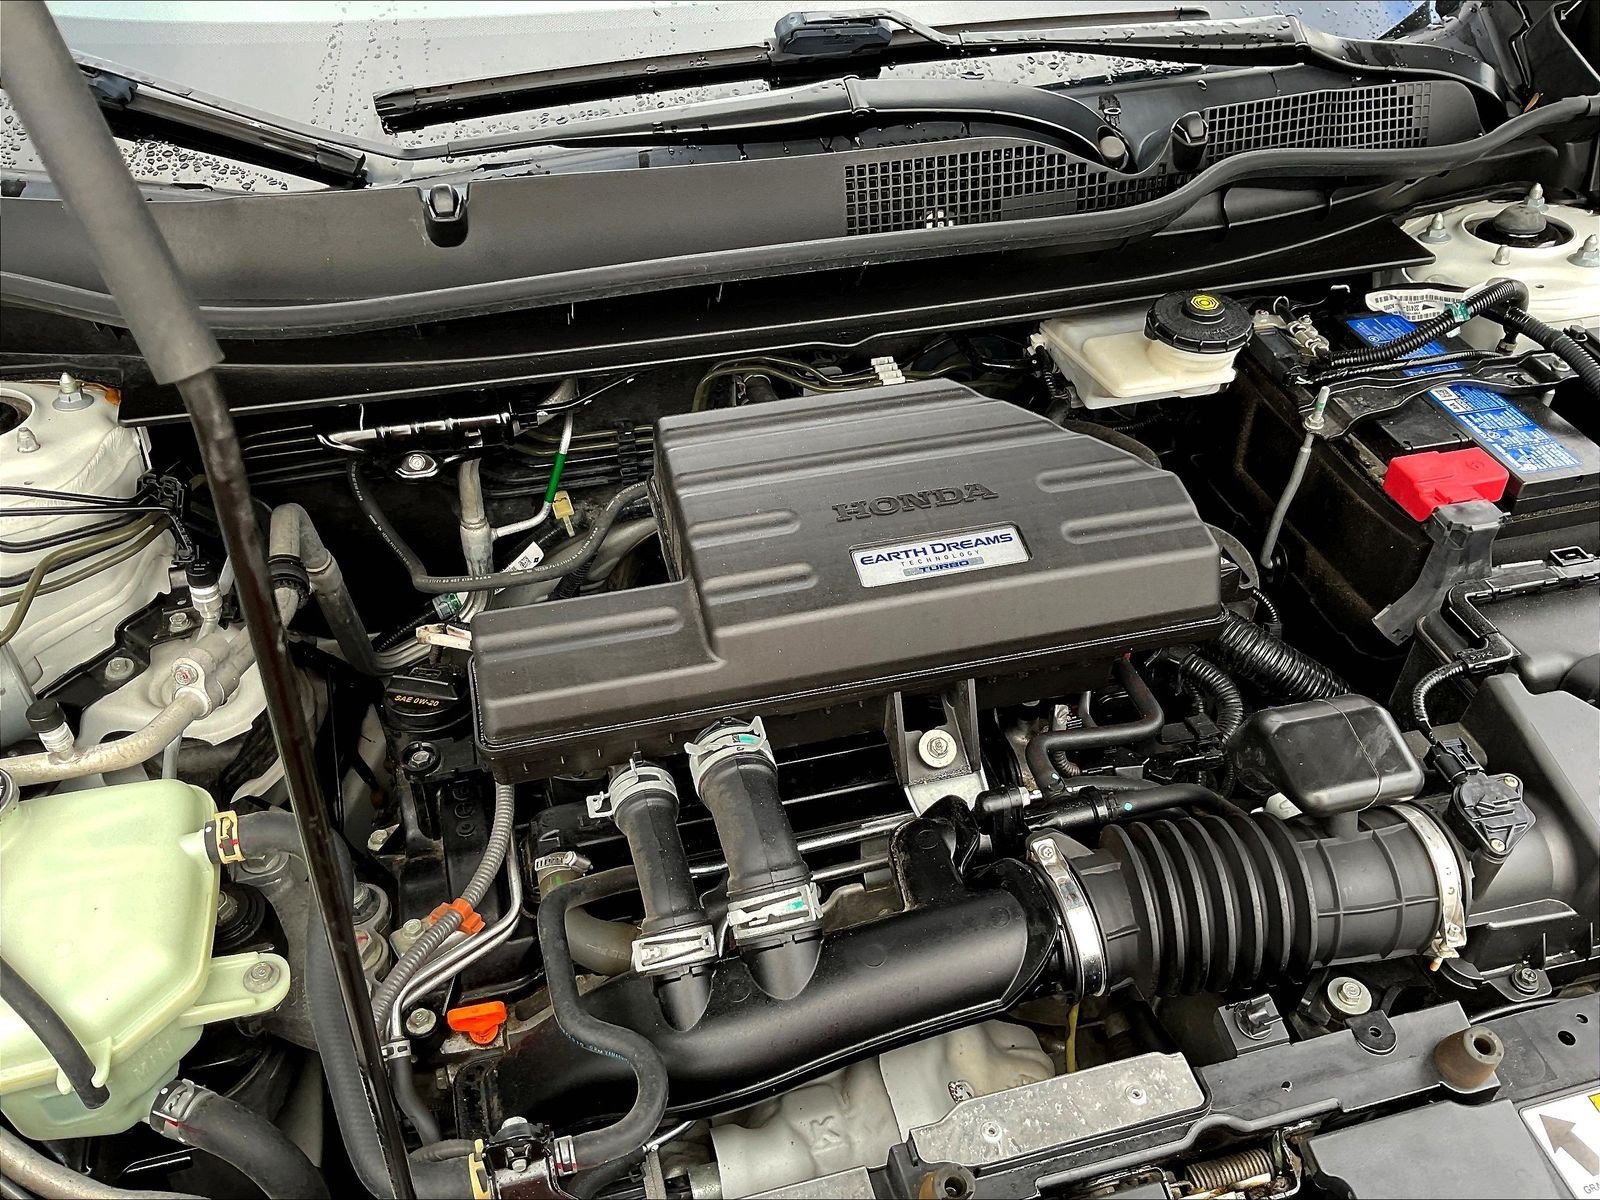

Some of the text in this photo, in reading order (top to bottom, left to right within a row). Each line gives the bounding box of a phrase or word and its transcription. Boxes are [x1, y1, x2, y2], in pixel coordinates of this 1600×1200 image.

[832, 483, 999, 523] HONDA
[860, 533, 1013, 566] EARTH DREAMS
[901, 549, 980, 567] TECHNOLOGY
[919, 560, 970, 573] TURBO
[394, 694, 413, 703] SAE
